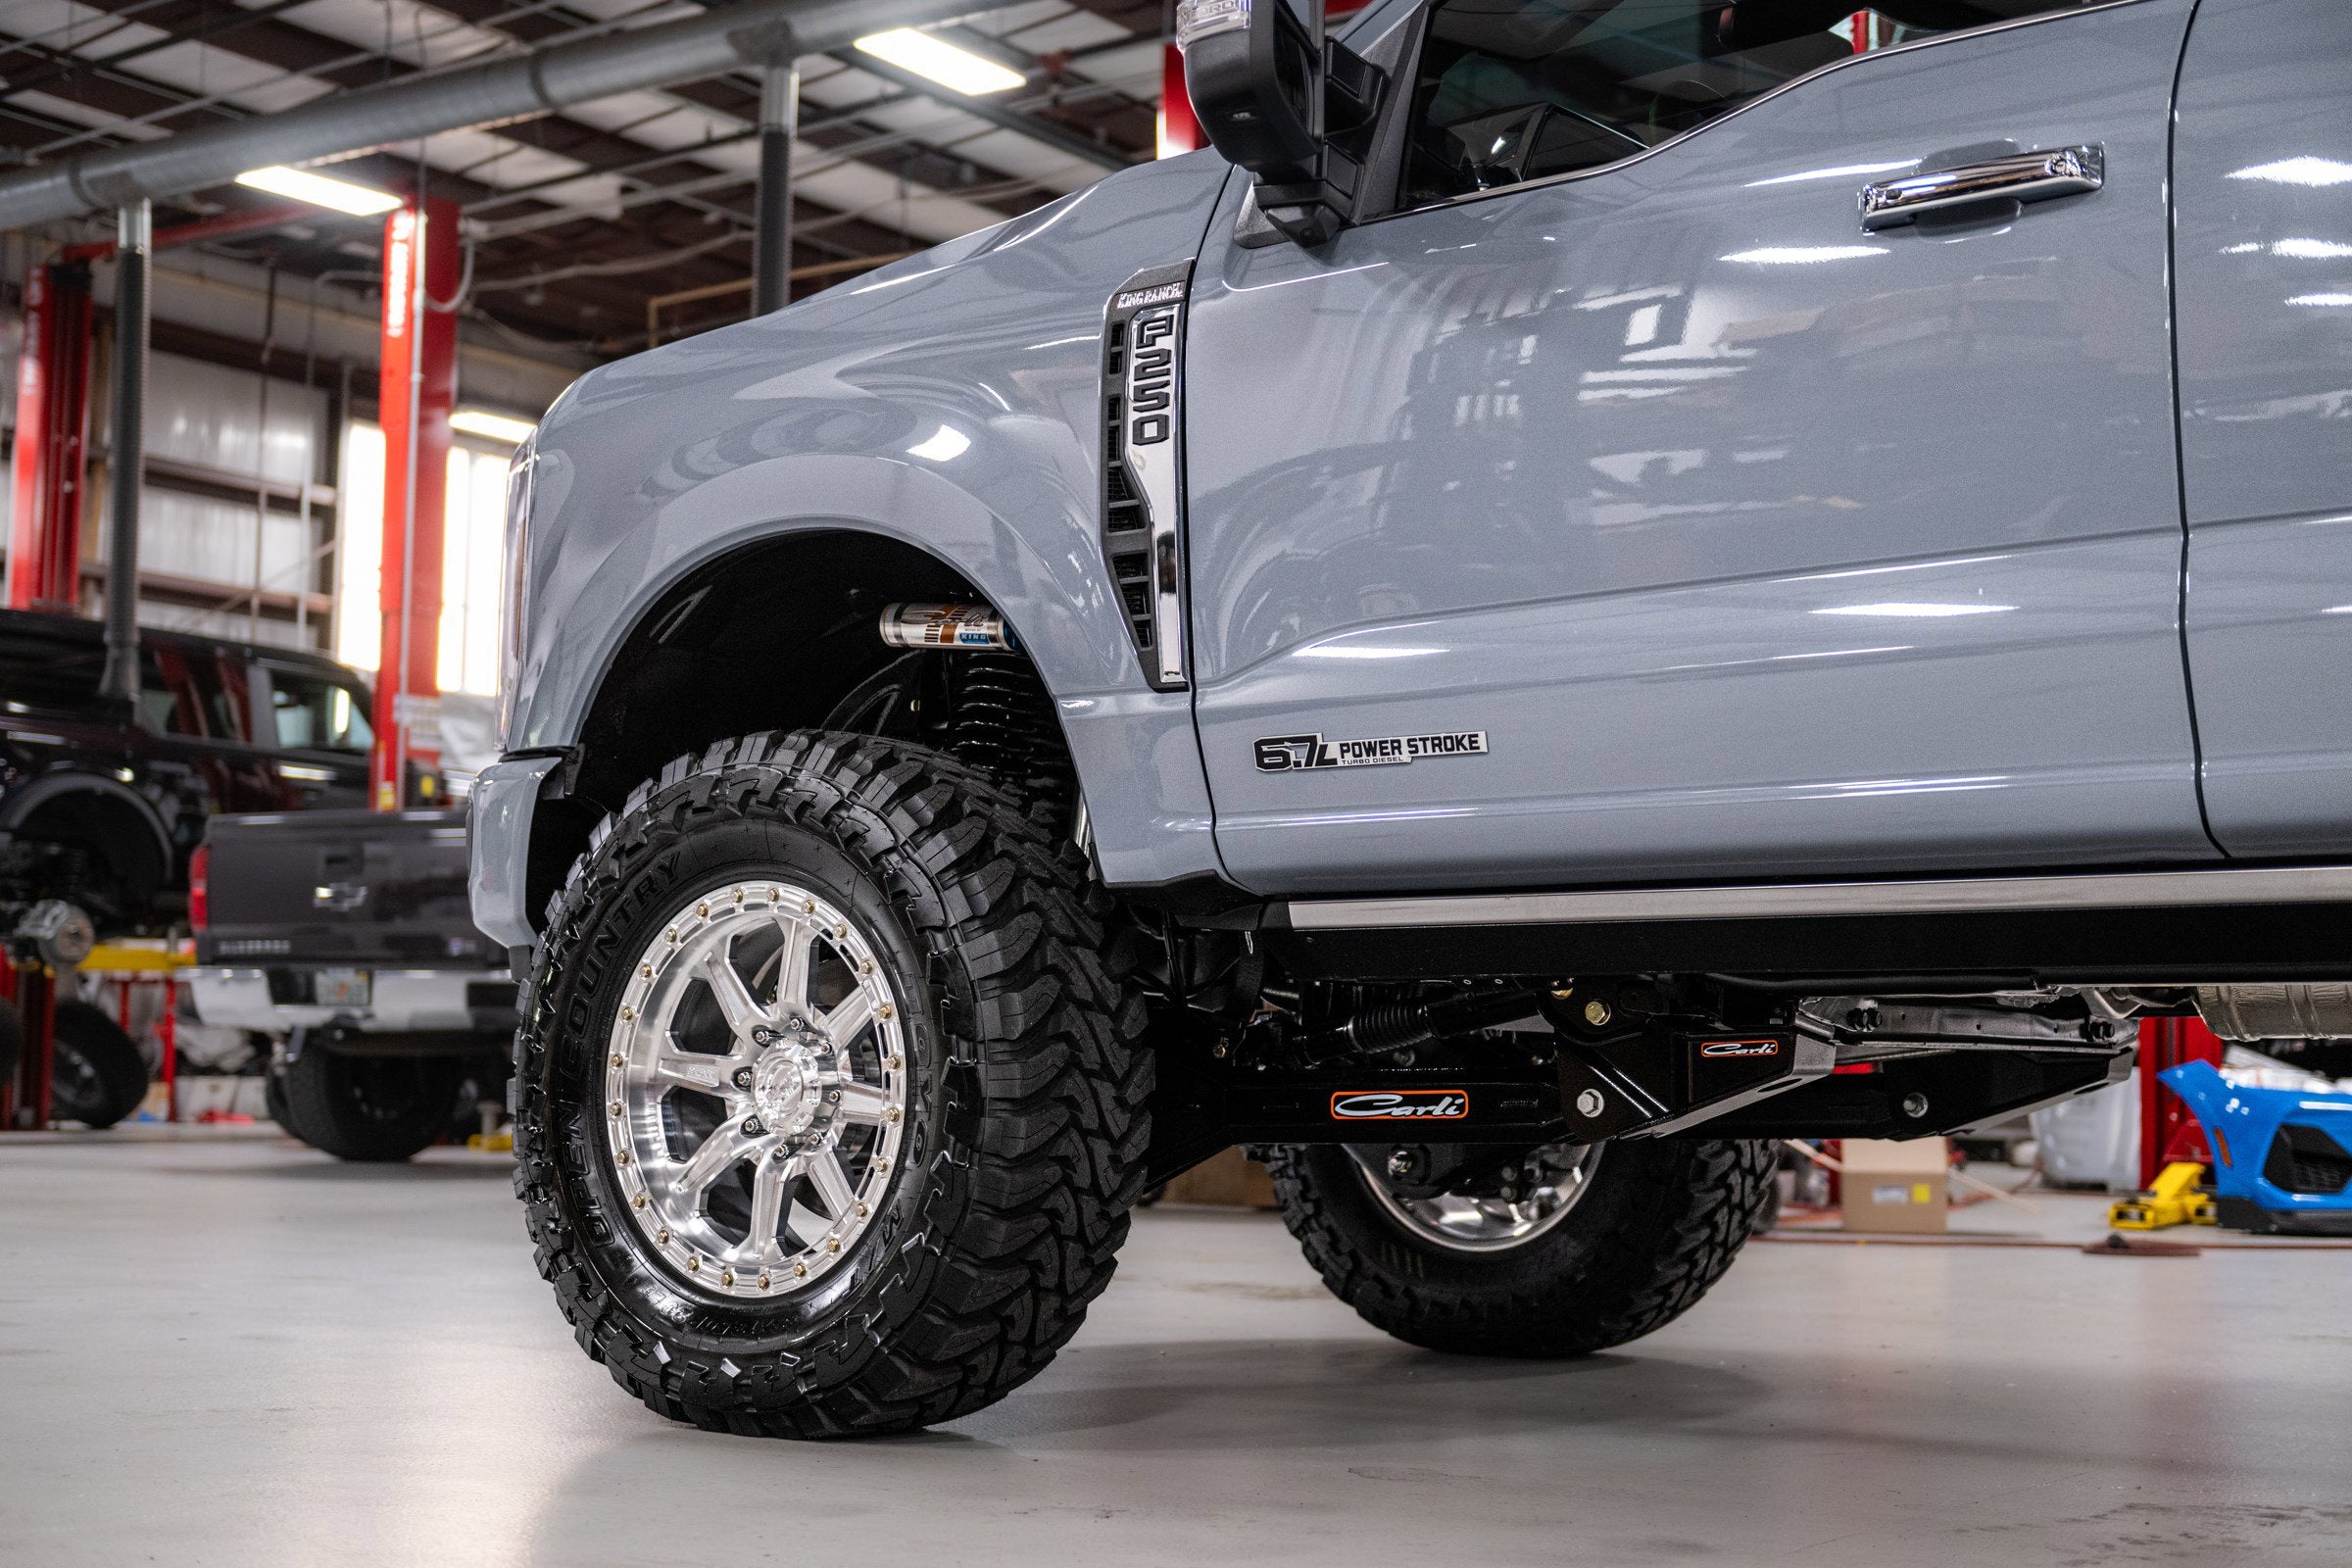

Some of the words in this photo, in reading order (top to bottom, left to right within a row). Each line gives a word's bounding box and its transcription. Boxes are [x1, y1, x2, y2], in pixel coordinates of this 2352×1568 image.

[1117, 293, 1144, 309] KING
[1144, 282, 1183, 304] RANCH
[1253, 734, 1338, 770] 6.7L
[1339, 738, 1402, 760] POWER
[1406, 733, 1480, 755] STROKE
[559, 850, 681, 1079] COUNTRY
[1703, 1043, 1776, 1055] Carli
[1334, 1093, 1465, 1117] Carli
[559, 1099, 615, 1249] OPEN
